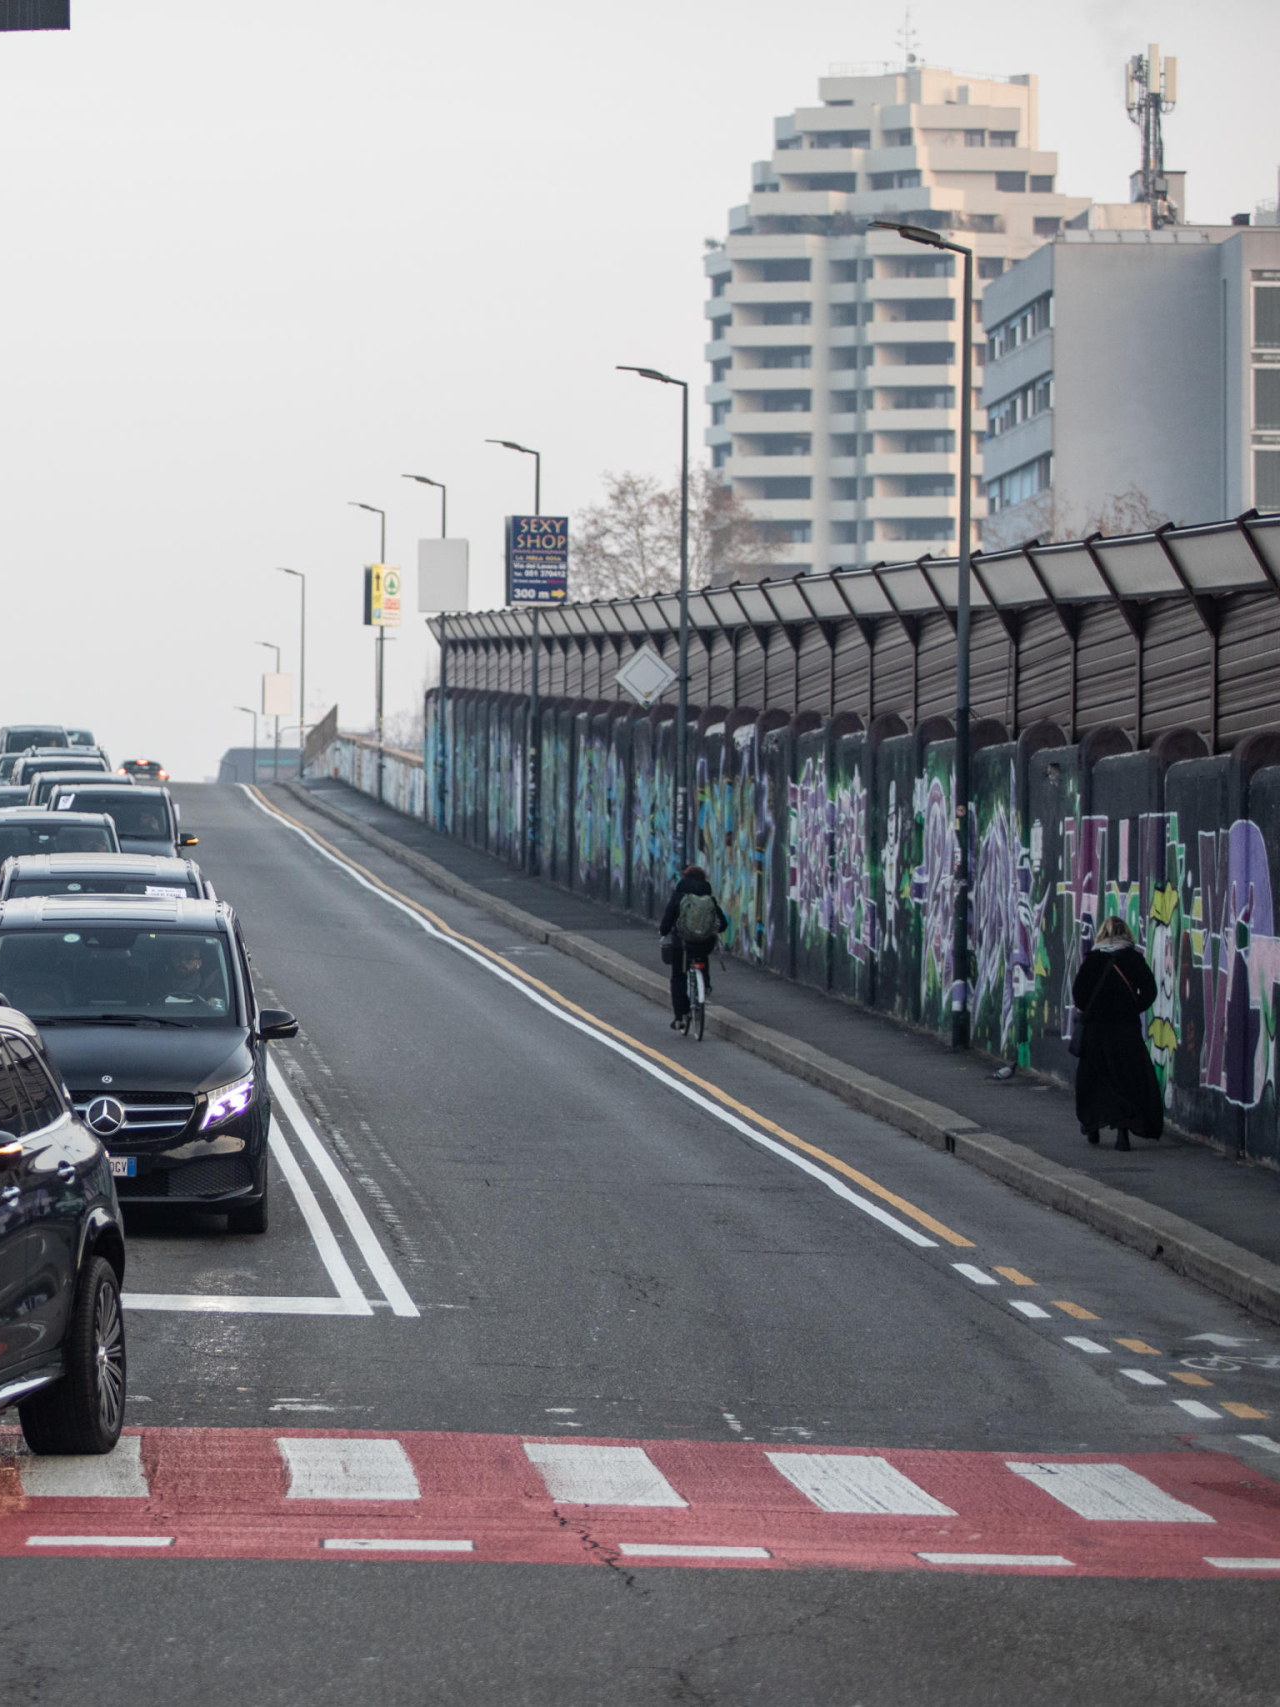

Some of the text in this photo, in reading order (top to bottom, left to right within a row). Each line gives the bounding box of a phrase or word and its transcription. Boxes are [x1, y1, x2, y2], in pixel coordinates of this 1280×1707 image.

[520, 518, 565, 533] SEXY
[517, 534, 566, 549] SHOP
[514, 588, 550, 599] 300 m
